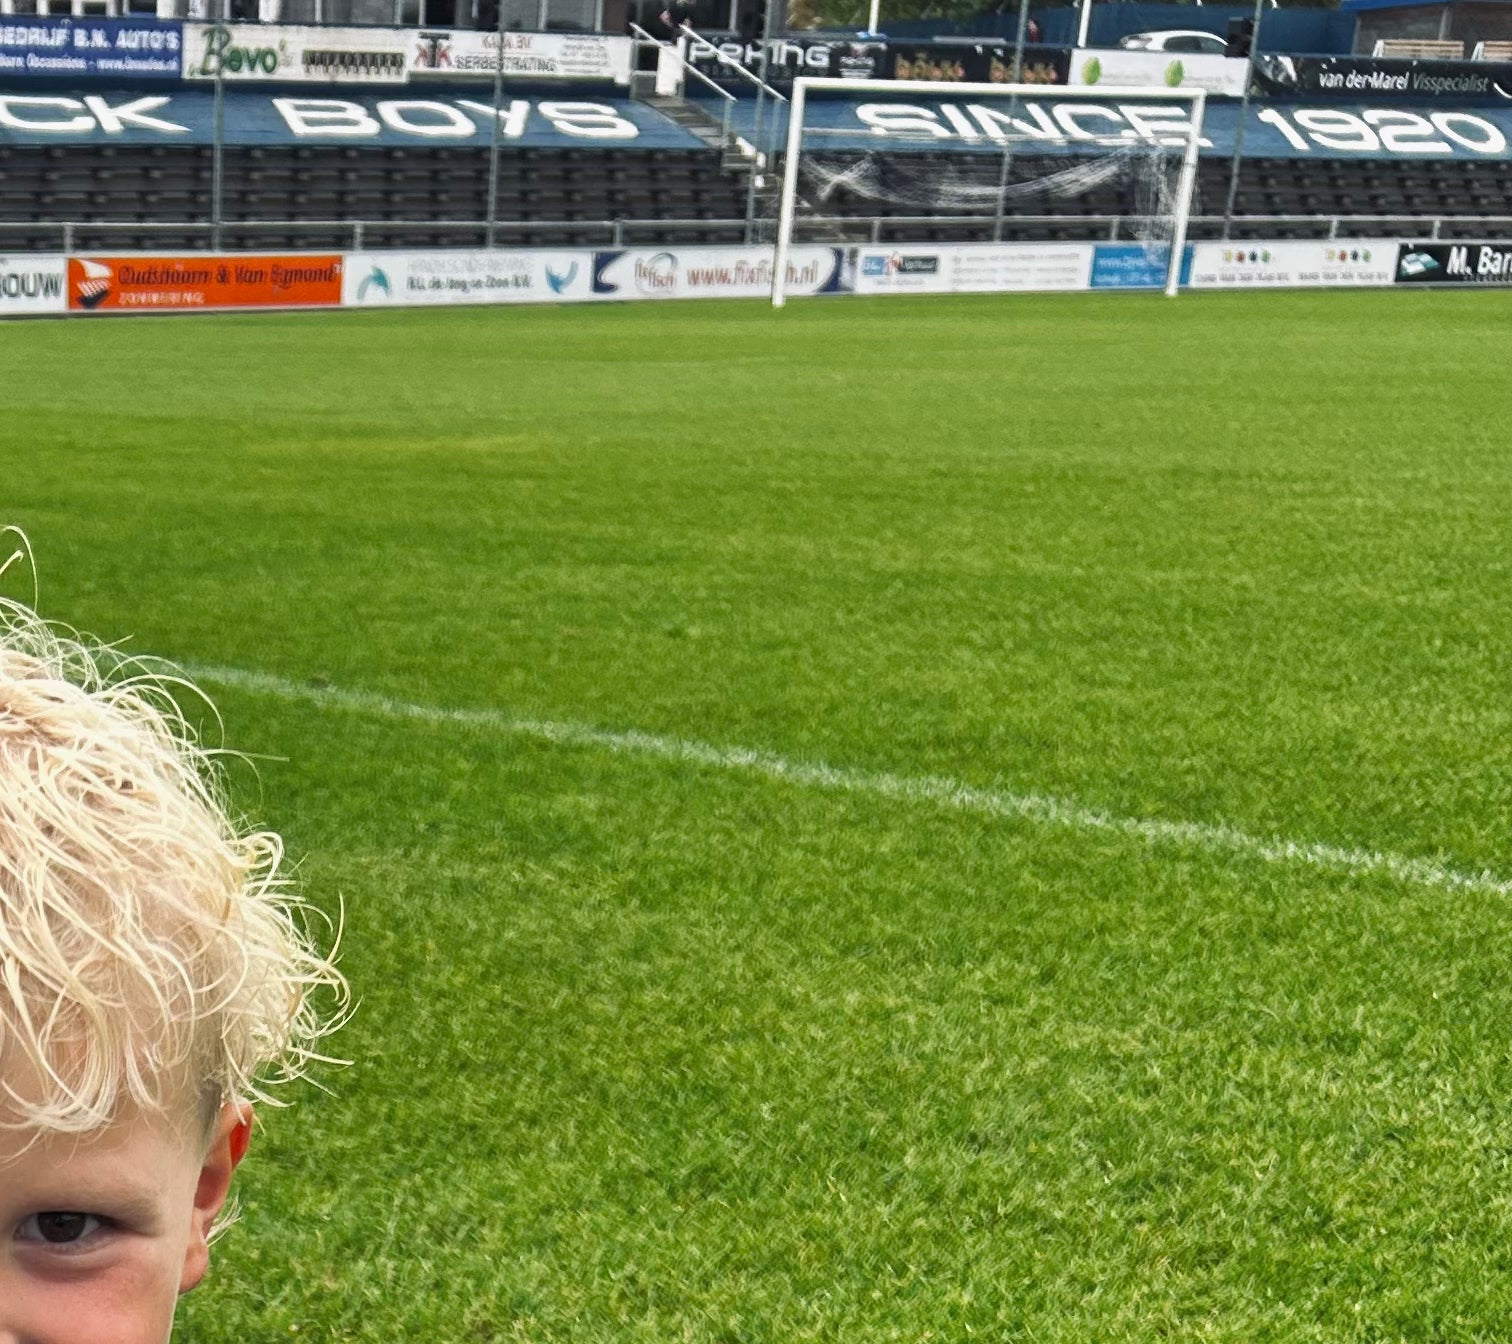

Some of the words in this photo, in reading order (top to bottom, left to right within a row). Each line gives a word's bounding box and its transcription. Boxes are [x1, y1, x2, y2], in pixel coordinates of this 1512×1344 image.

[1319, 71, 1343, 87] van
[1413, 73, 1489, 94] Visspecialist
[272, 98, 640, 138] BOYS
[855, 103, 1214, 147] SINCE
[1257, 108, 1507, 154] 1920
[1477, 246, 1512, 275] Bar
